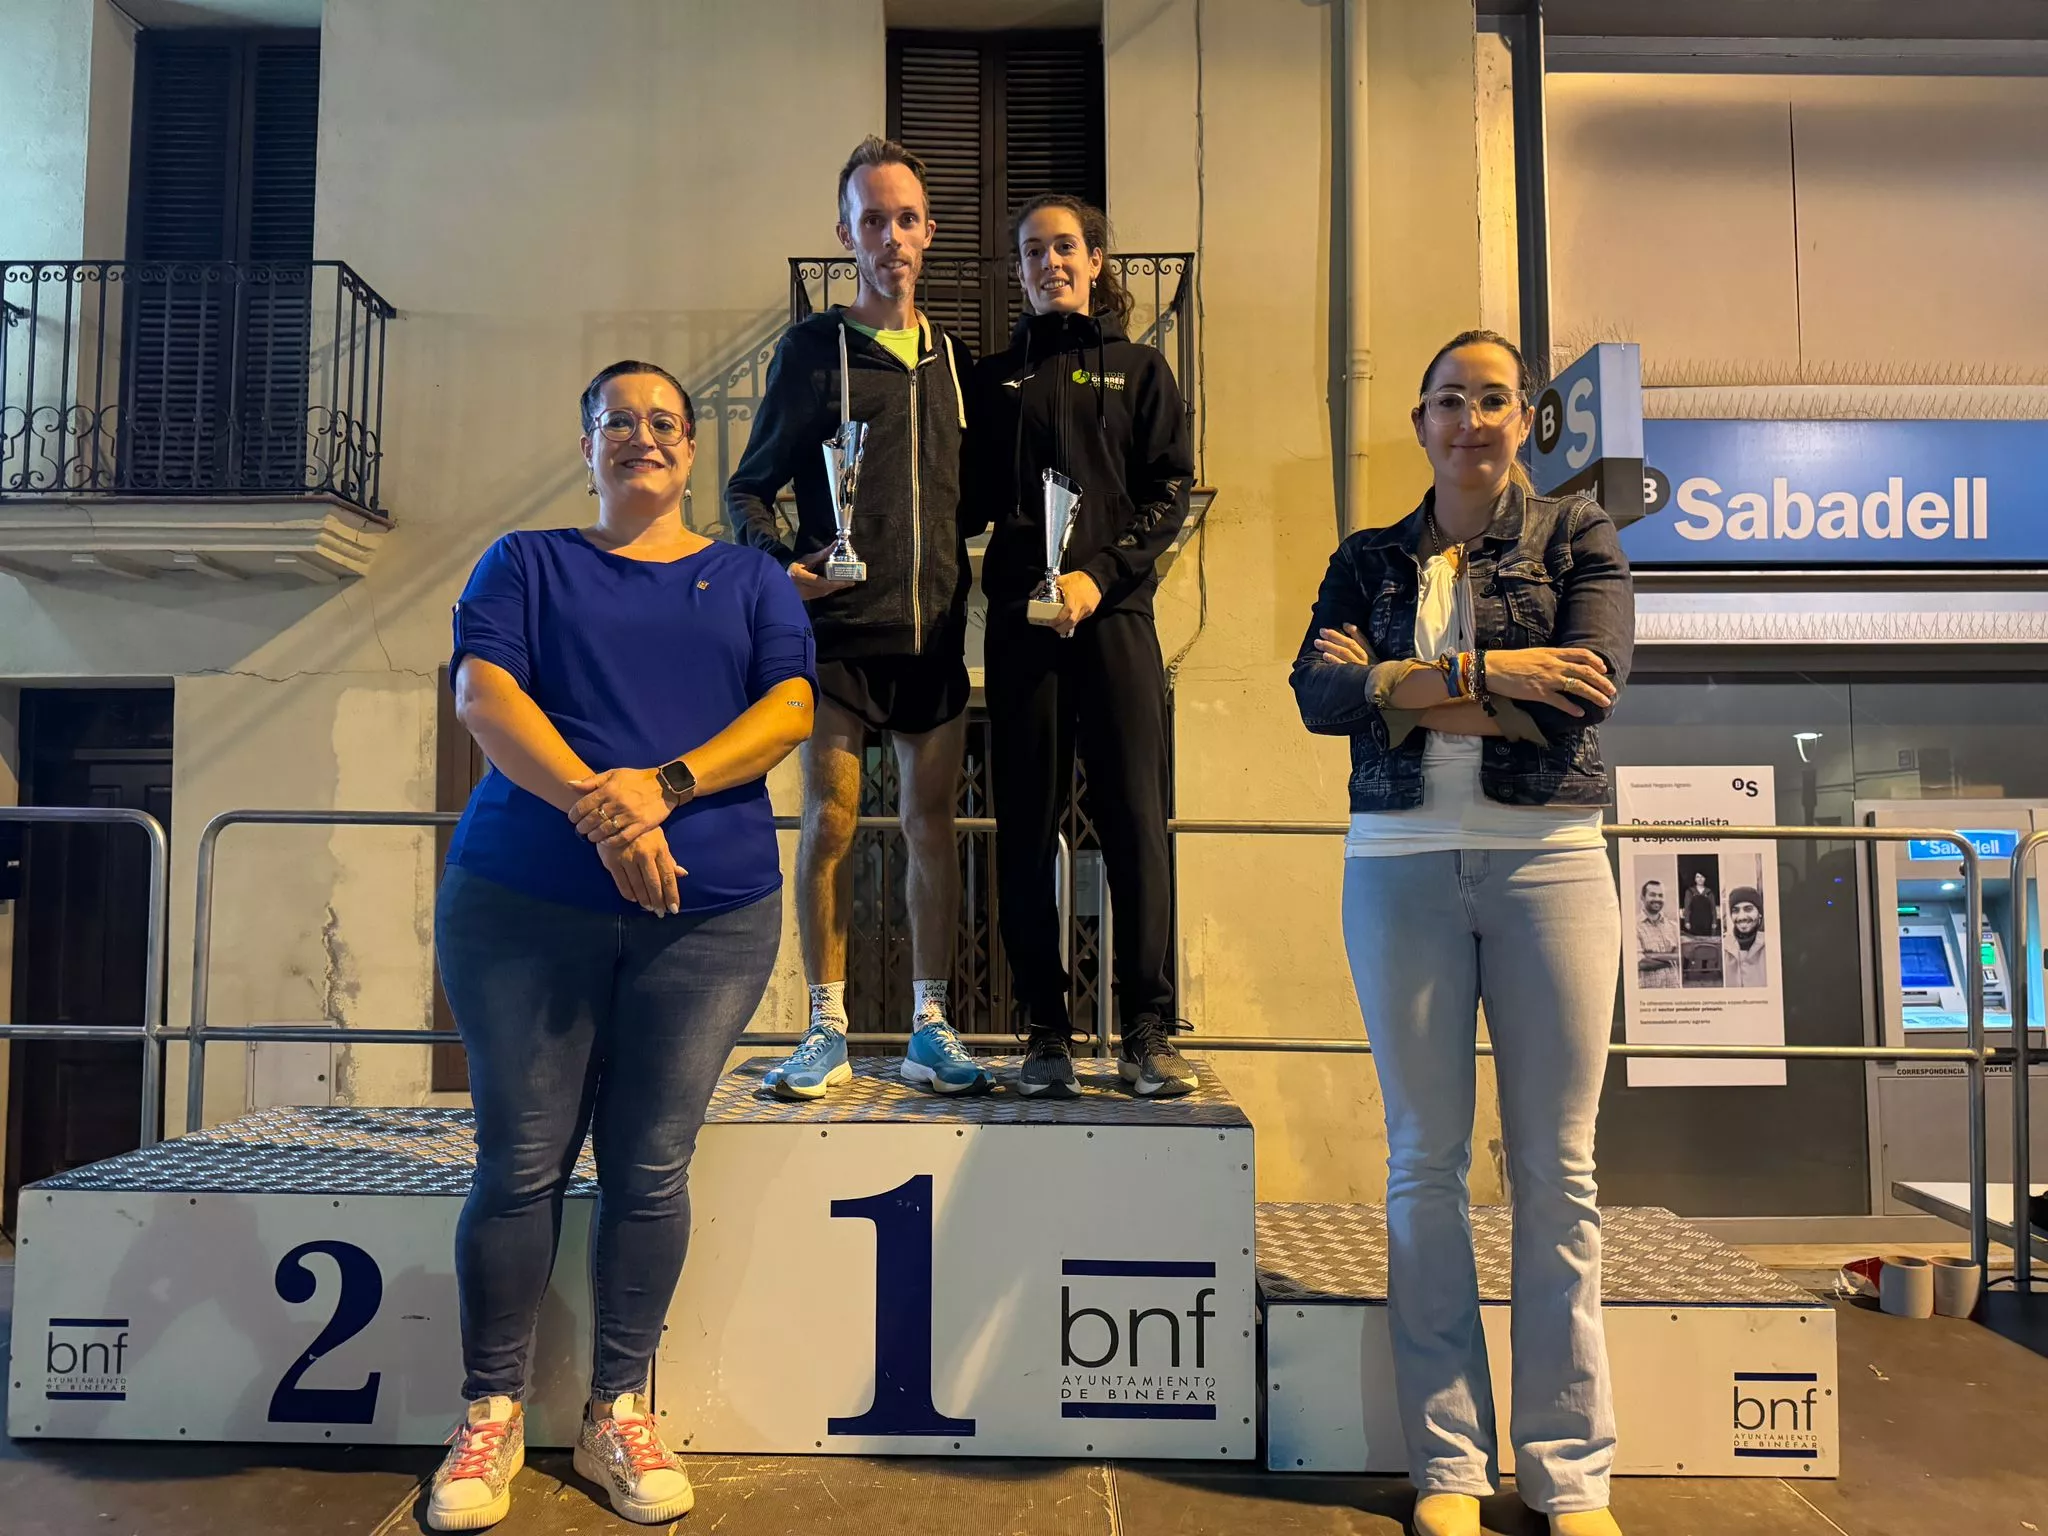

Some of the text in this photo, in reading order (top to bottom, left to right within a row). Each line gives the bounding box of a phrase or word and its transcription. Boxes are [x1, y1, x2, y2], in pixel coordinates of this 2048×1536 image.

[1541, 377, 1596, 469] B S
[1643, 478, 1658, 503] B
[1674, 477, 1987, 540] Sabadell
[1929, 840, 2000, 854] Sabdell
[1896, 1068, 1965, 1076] CORRESPONDENCIA
[828, 1174, 976, 1436] 1
[268, 1240, 383, 1425] 2
[1061, 1286, 1216, 1369] bnf
[47, 1331, 129, 1375] bnf
[47, 1377, 127, 1385] AYUNTAMIENTO
[1061, 1387, 1217, 1401] DE BINÉFAR
[1062, 1375, 1216, 1387] AYUNTAMIENTO
[1733, 1386, 1817, 1431] bnf
[1734, 1433, 1817, 1441] AYUNTAMIENTO
[1759, 1440, 1817, 1449] BINÉFAR
